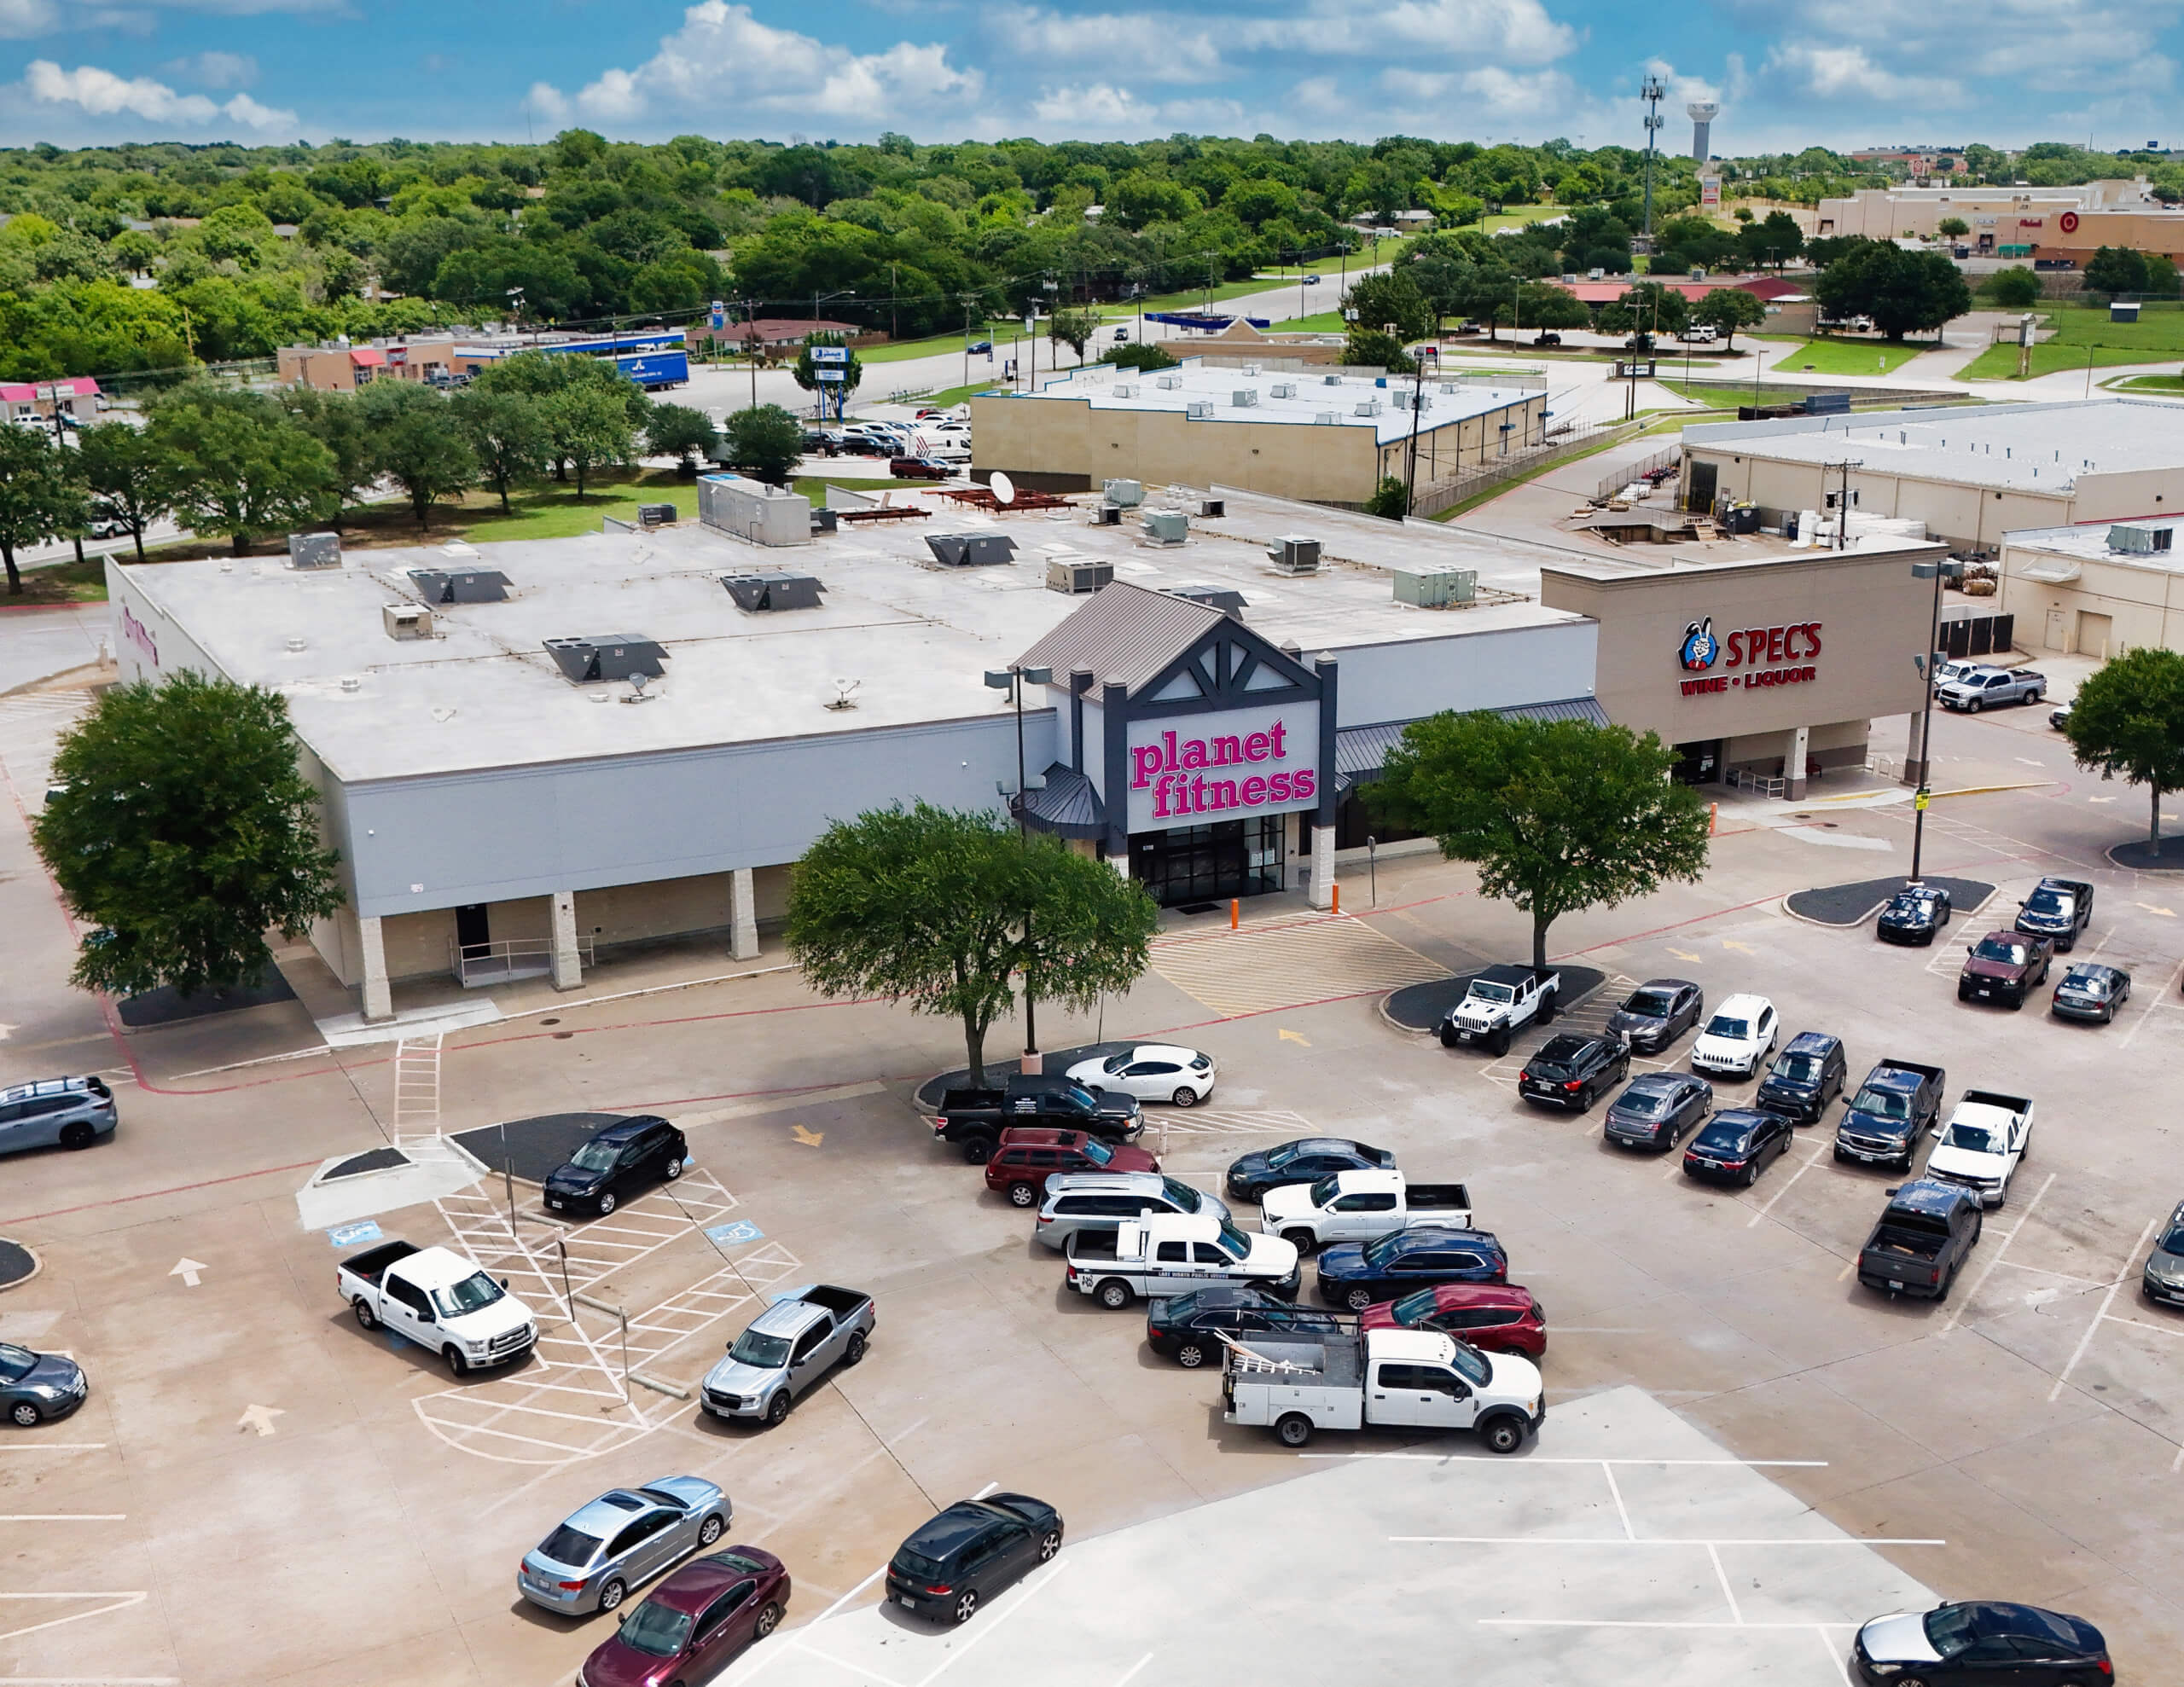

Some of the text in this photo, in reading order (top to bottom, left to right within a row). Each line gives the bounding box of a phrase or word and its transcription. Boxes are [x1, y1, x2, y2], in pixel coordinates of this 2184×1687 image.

[1725, 621, 1822, 669] SPEC'S
[1679, 664, 1816, 696] WINE LIQUOR
[1131, 717, 1287, 790] planet
[1153, 768, 1316, 820] fitness
